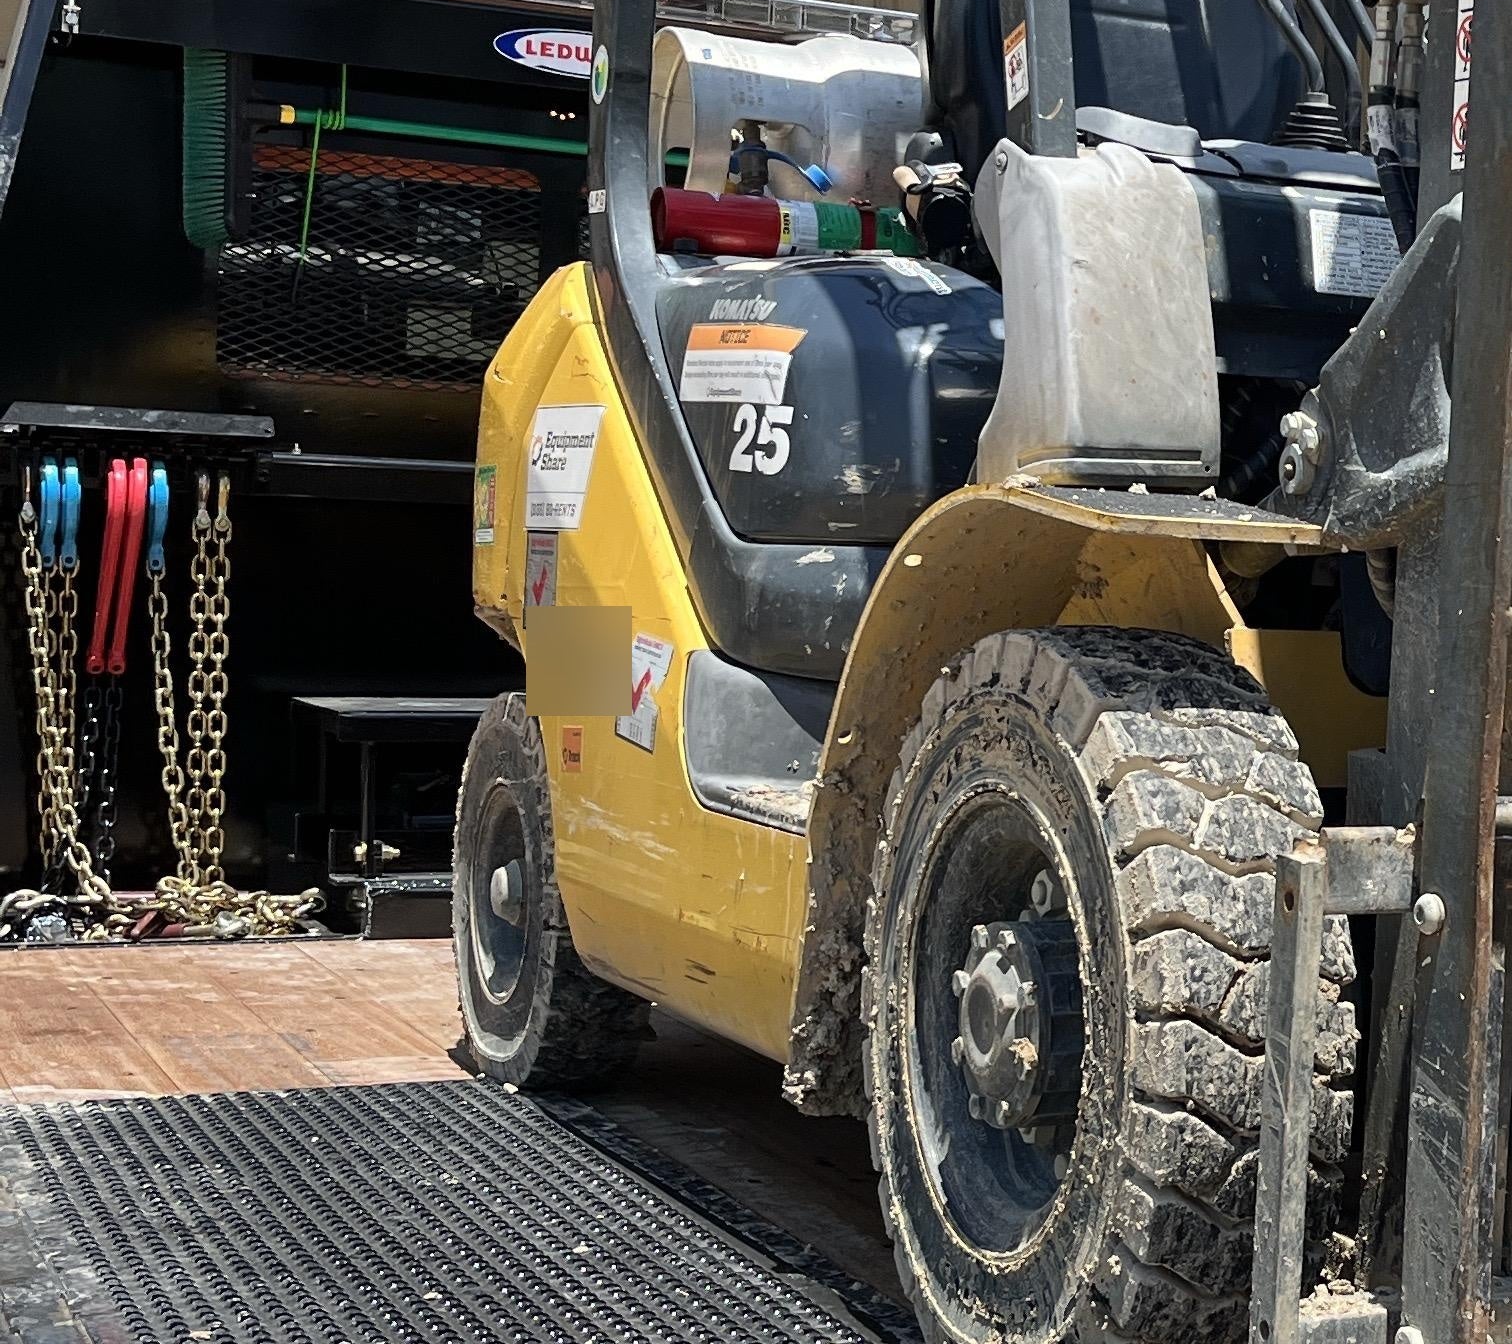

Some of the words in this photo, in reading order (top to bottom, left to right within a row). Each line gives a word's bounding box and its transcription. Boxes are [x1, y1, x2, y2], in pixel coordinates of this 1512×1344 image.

[708, 294, 778, 321] KOMATSU
[544, 430, 595, 453] Equipment
[729, 403, 795, 476] 25
[540, 453, 567, 471] Share
